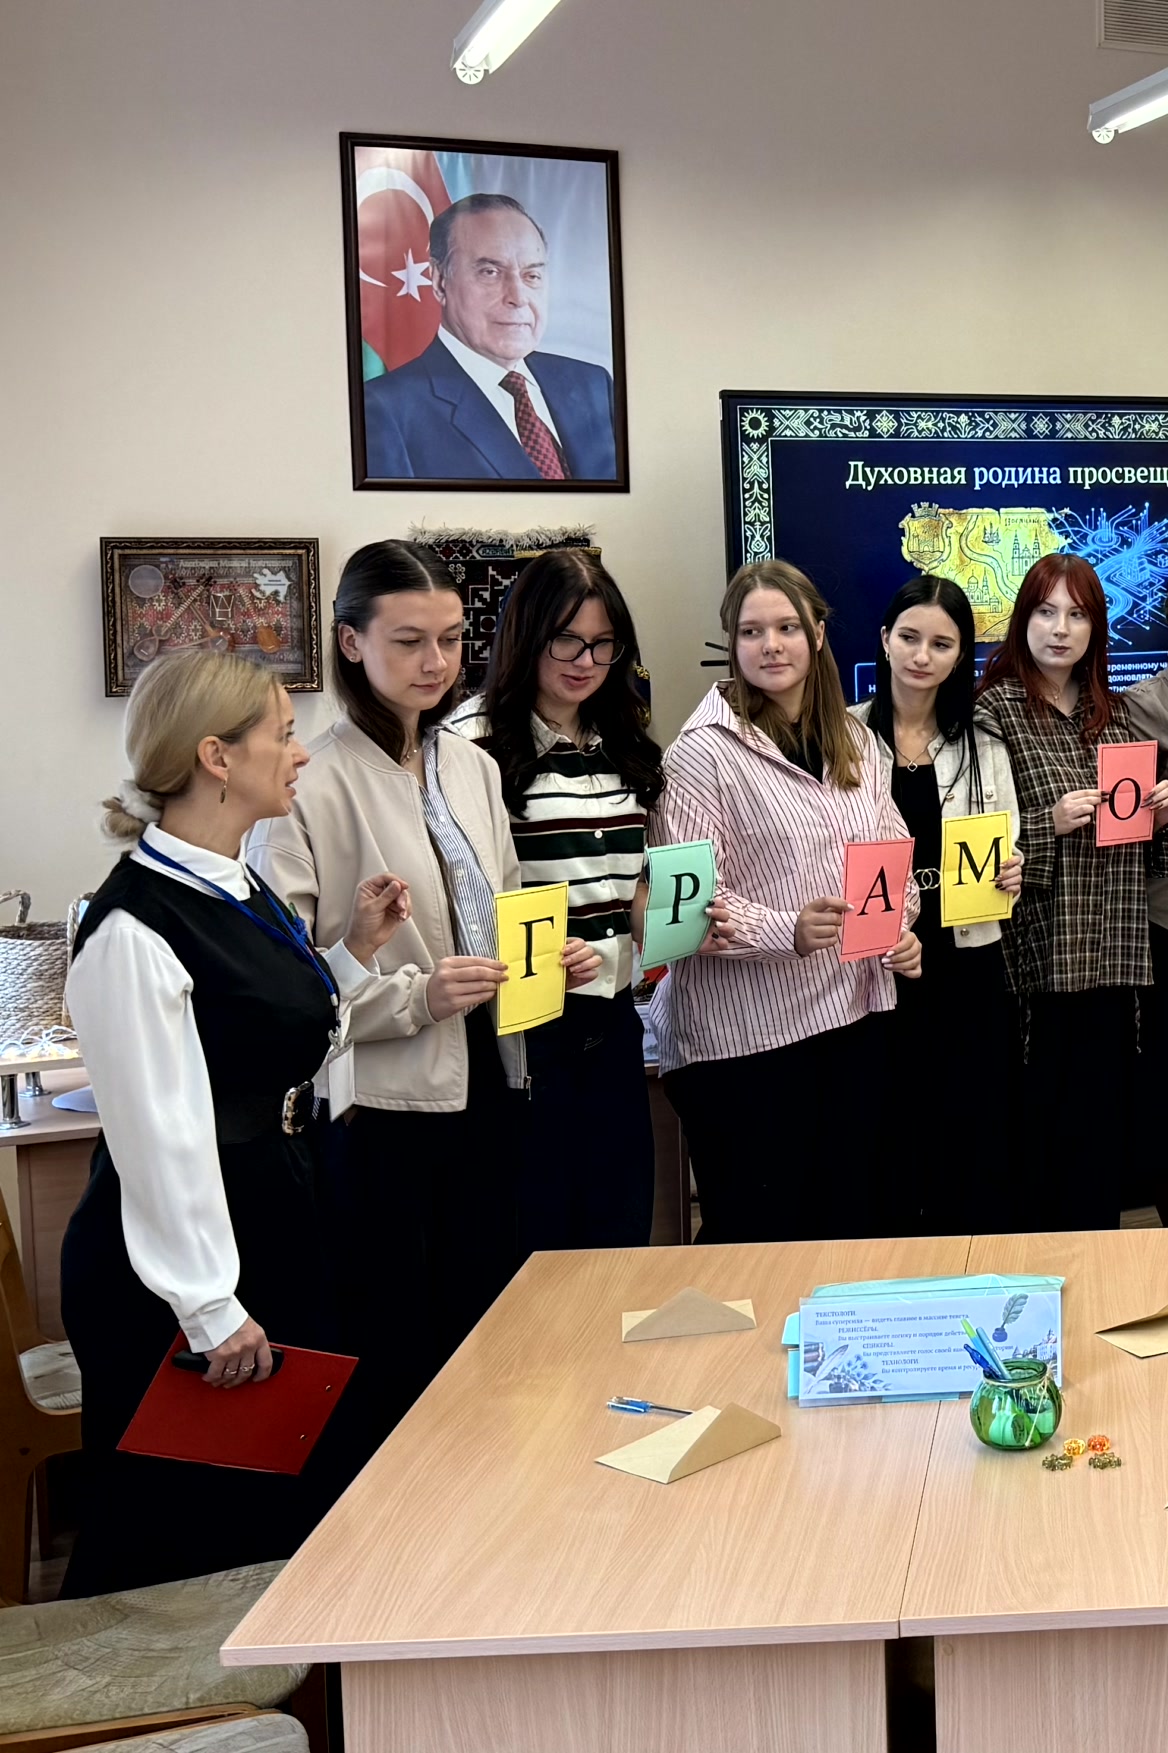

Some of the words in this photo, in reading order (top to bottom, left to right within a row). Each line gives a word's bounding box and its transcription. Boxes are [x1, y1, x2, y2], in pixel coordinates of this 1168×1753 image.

[845, 461, 967, 490] Духовная
[973, 464, 1062, 490] родина
[1108, 777, 1141, 821] О
[952, 836, 1005, 886] М
[665, 872, 700, 926] Р
[857, 865, 896, 916] А
[519, 916, 555, 979] Г
